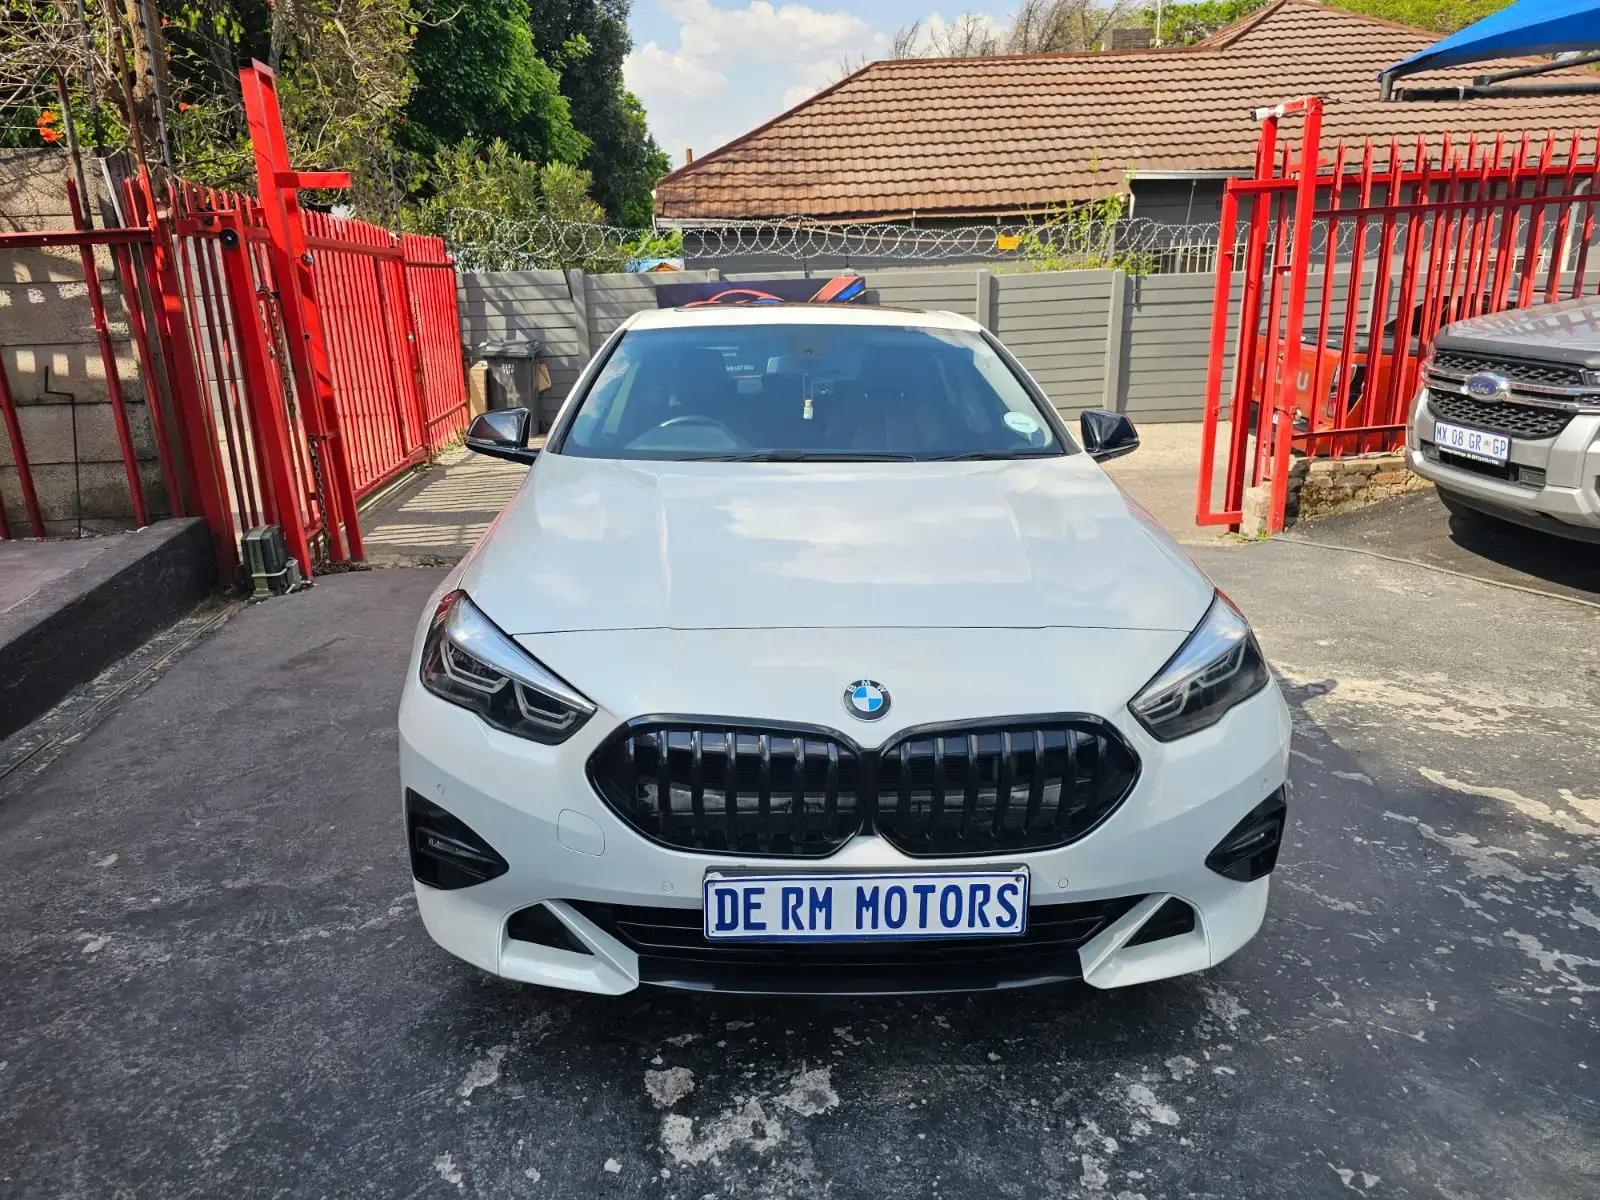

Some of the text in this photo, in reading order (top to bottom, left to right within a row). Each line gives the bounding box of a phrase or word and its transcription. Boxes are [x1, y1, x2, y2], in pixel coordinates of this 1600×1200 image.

[1468, 433, 1482, 451] GR
[1492, 438, 1507, 456] GP
[847, 680, 887, 693] BMW
[715, 883, 1019, 931] DE RM MOTORS
